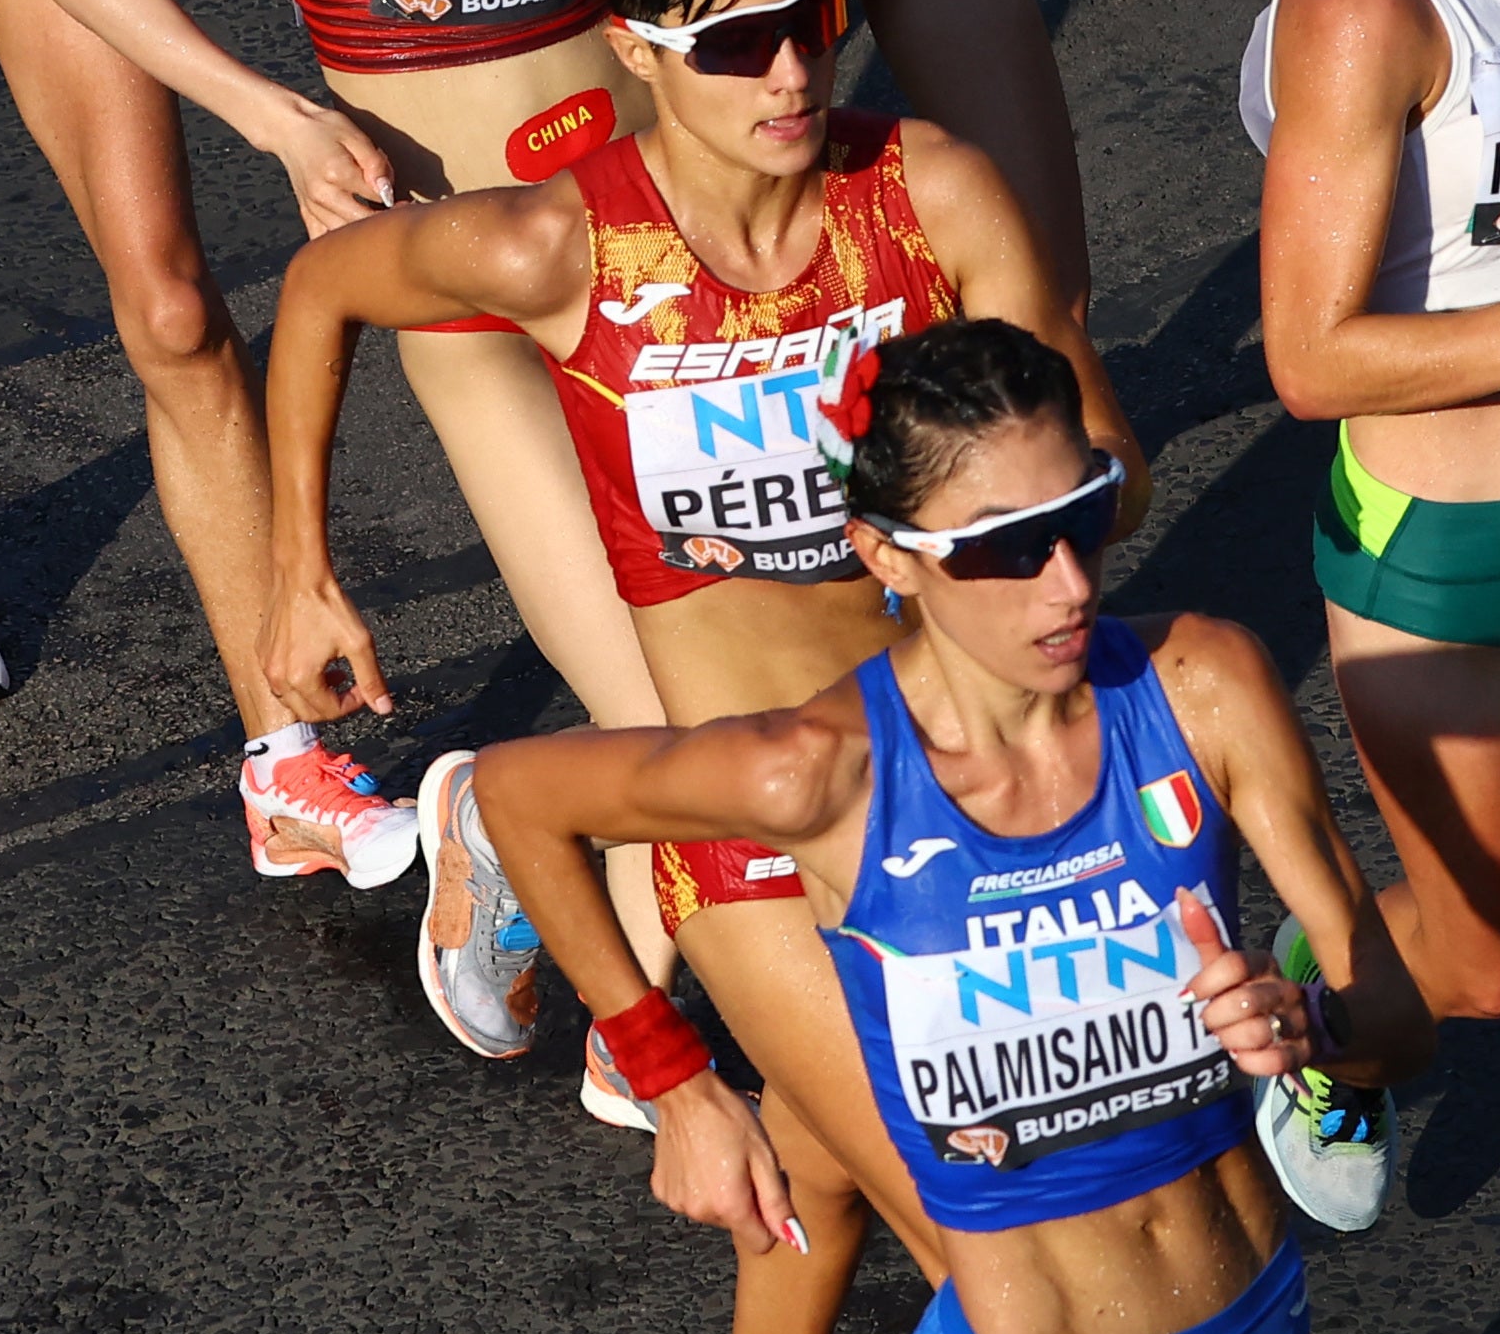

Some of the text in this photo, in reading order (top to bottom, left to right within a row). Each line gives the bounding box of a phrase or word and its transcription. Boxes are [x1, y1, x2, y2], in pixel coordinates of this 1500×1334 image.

[527, 105, 593, 152] CHINA
[691, 369, 821, 460] NT
[661, 468, 846, 530] PÉRE
[753, 538, 857, 572] BUDAP
[744, 854, 798, 882] ES
[970, 841, 1124, 894] FRECCIAROSSA
[966, 878, 1160, 951] ITALIA
[954, 919, 1178, 1027] NTN
[910, 1001, 1213, 1119] PALMISANO 1
[1015, 1061, 1230, 1145] BUDAPEST 23
